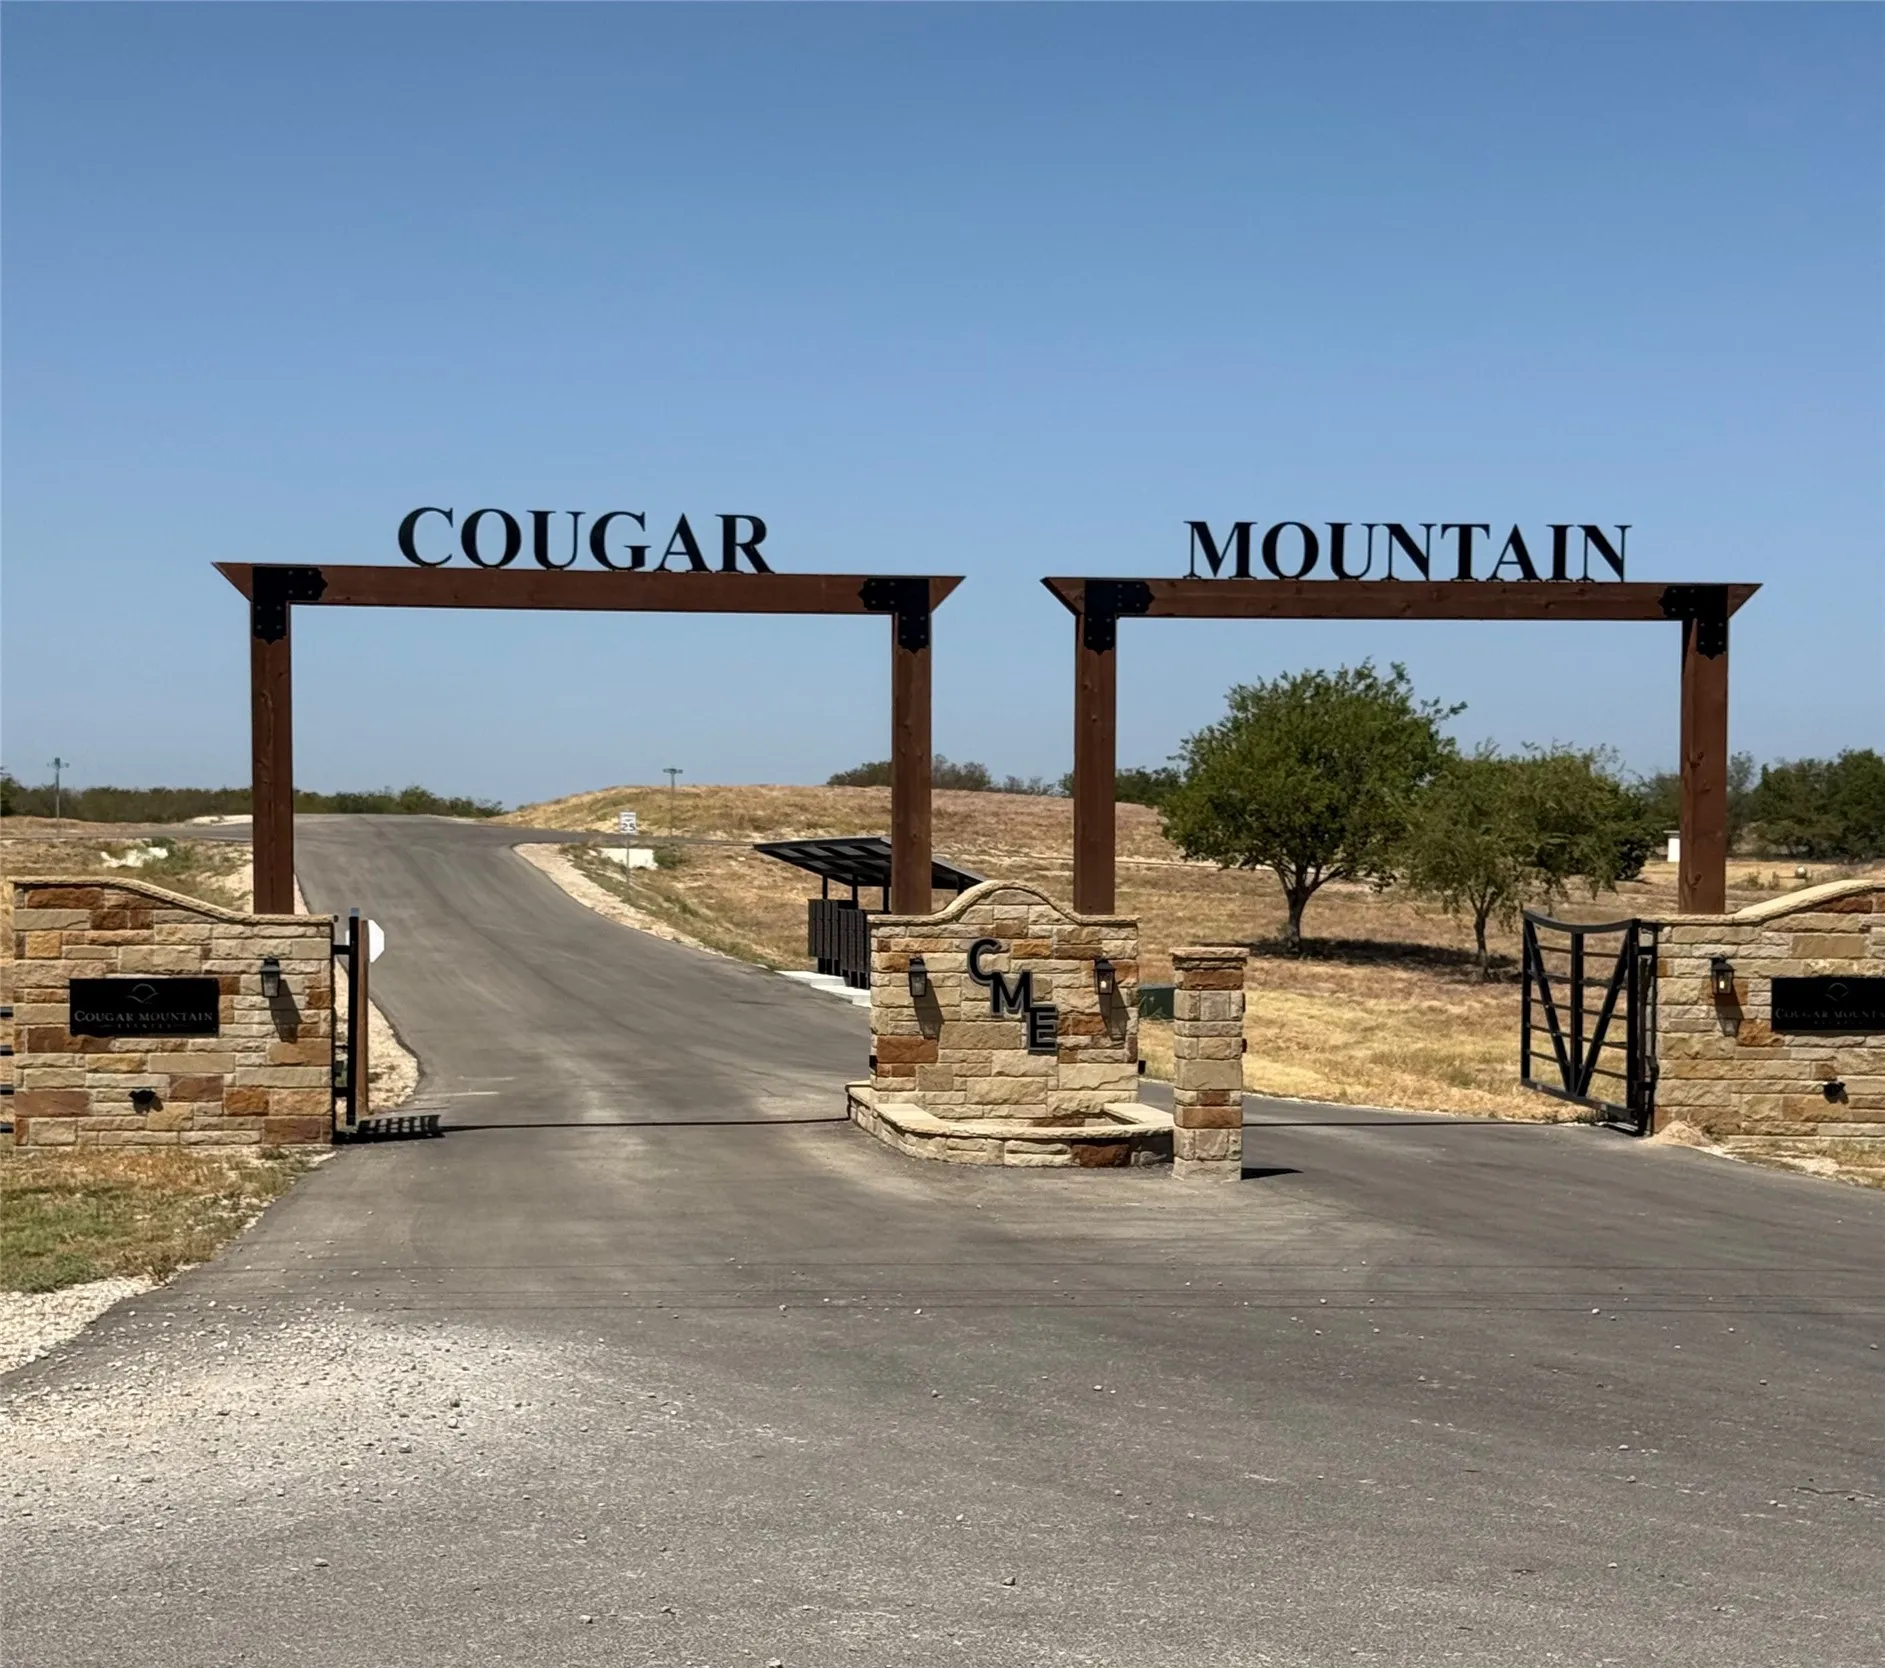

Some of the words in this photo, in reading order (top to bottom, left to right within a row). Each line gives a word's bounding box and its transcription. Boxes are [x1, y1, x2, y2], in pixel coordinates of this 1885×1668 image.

[398, 506, 775, 574] COUGAR
[1182, 520, 1632, 582] MOUNTAIN
[621, 822, 636, 831] 25
[74, 1009, 134, 1022] COUGAR
[138, 1011, 213, 1022] MOUNTAIN
